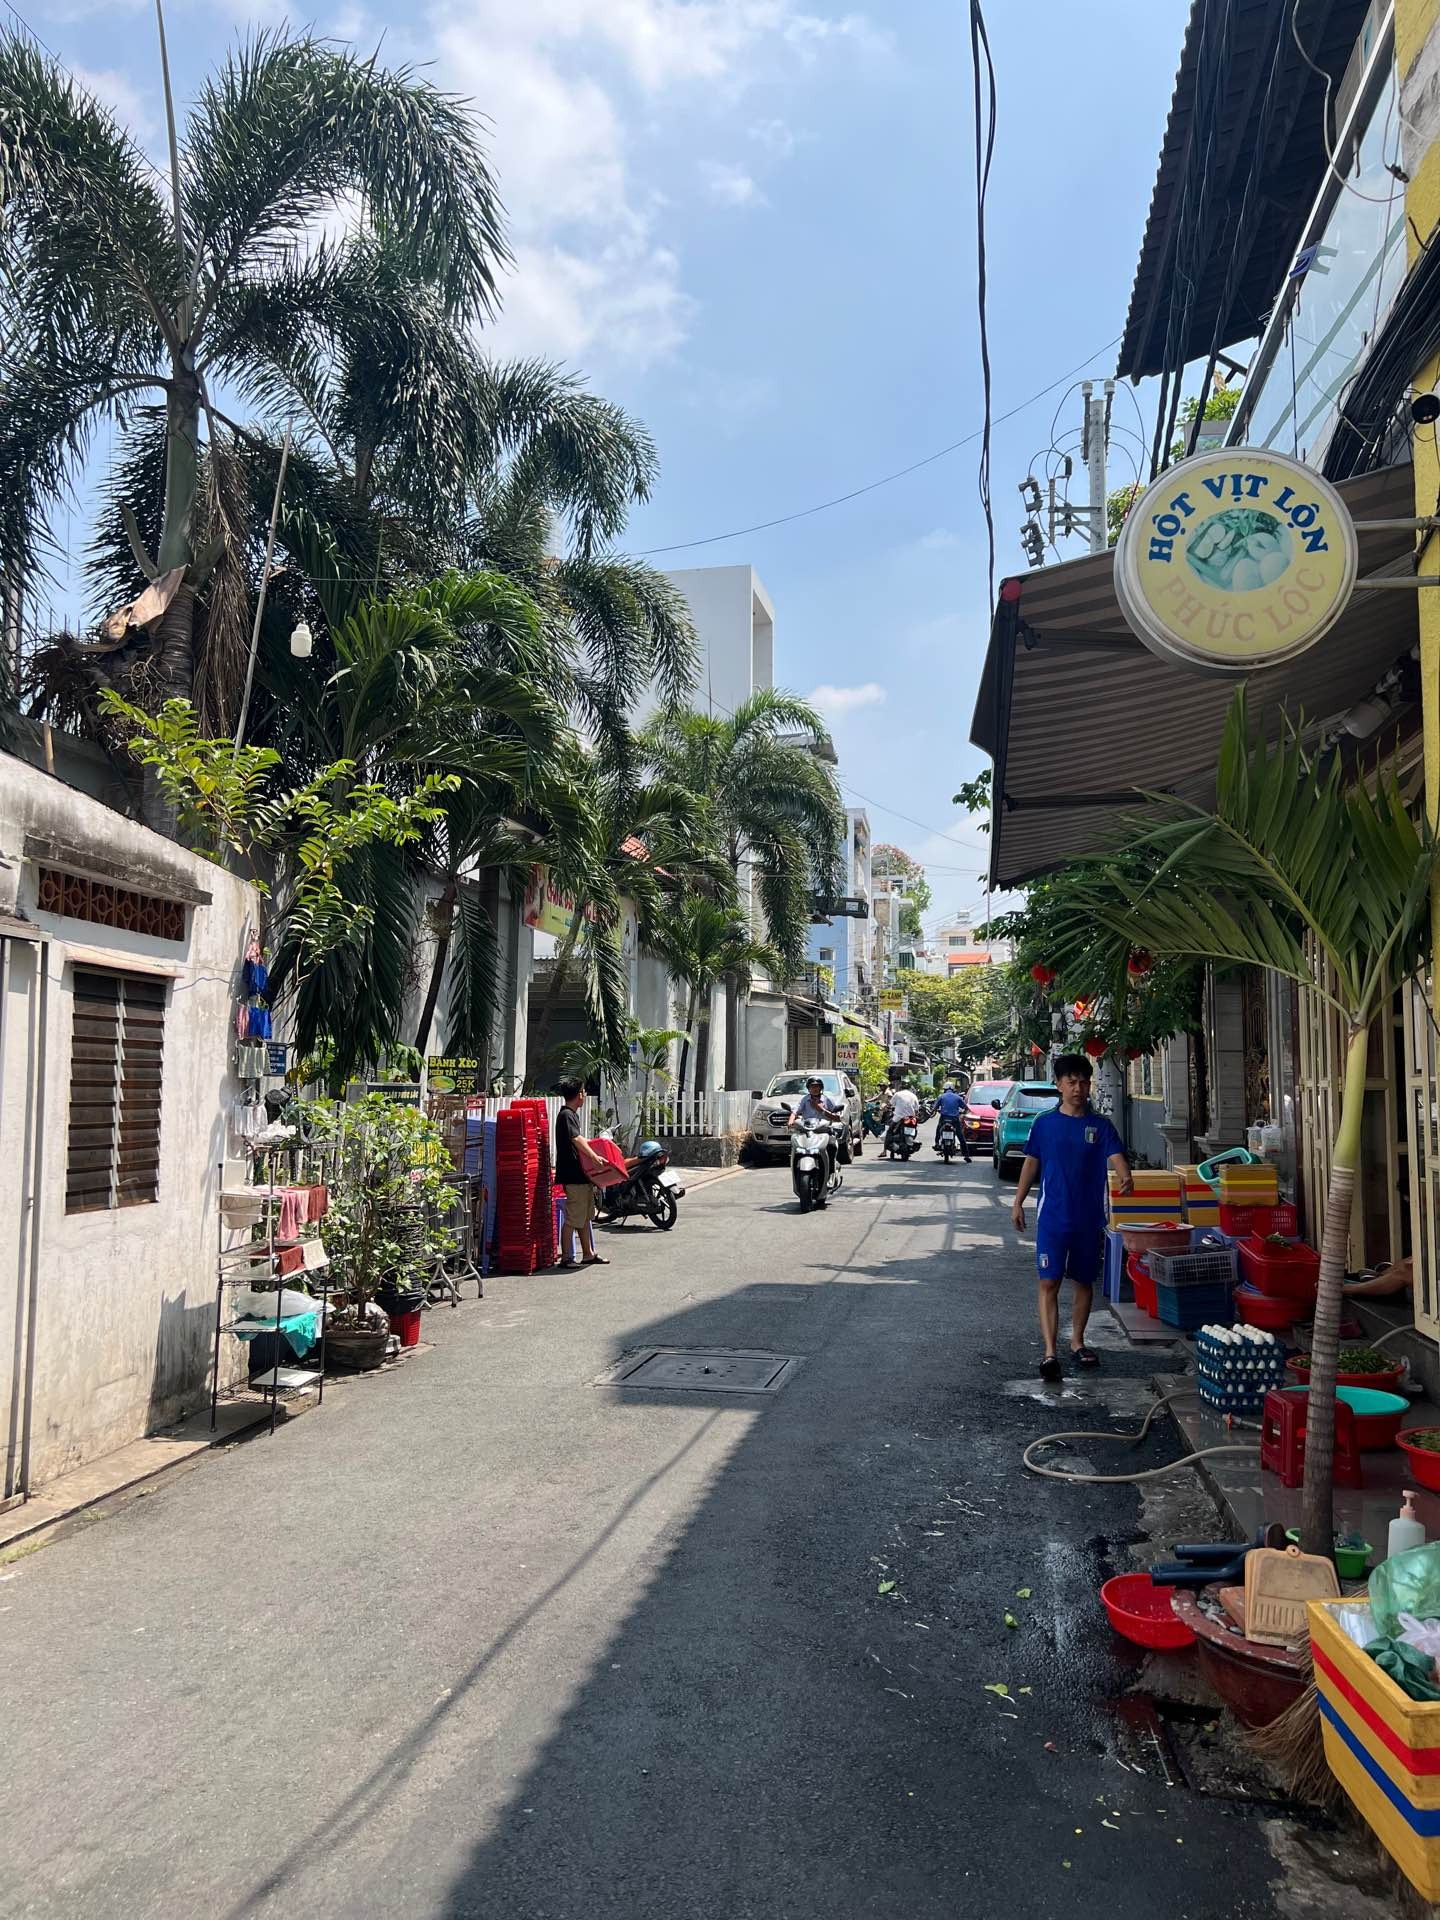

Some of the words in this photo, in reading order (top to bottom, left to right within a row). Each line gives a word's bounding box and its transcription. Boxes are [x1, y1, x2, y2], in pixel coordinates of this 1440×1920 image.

[1148, 492, 1196, 563] HỘT
[1202, 473, 1268, 502] VỊT
[1273, 486, 1329, 554] LỘN
[1158, 575, 1256, 642] PHÚC
[1263, 568, 1326, 634] LỘC
[429, 1056, 456, 1067] BÁNH
[458, 1057, 478, 1068] XÈO
[456, 1080, 475, 1088] 25K
